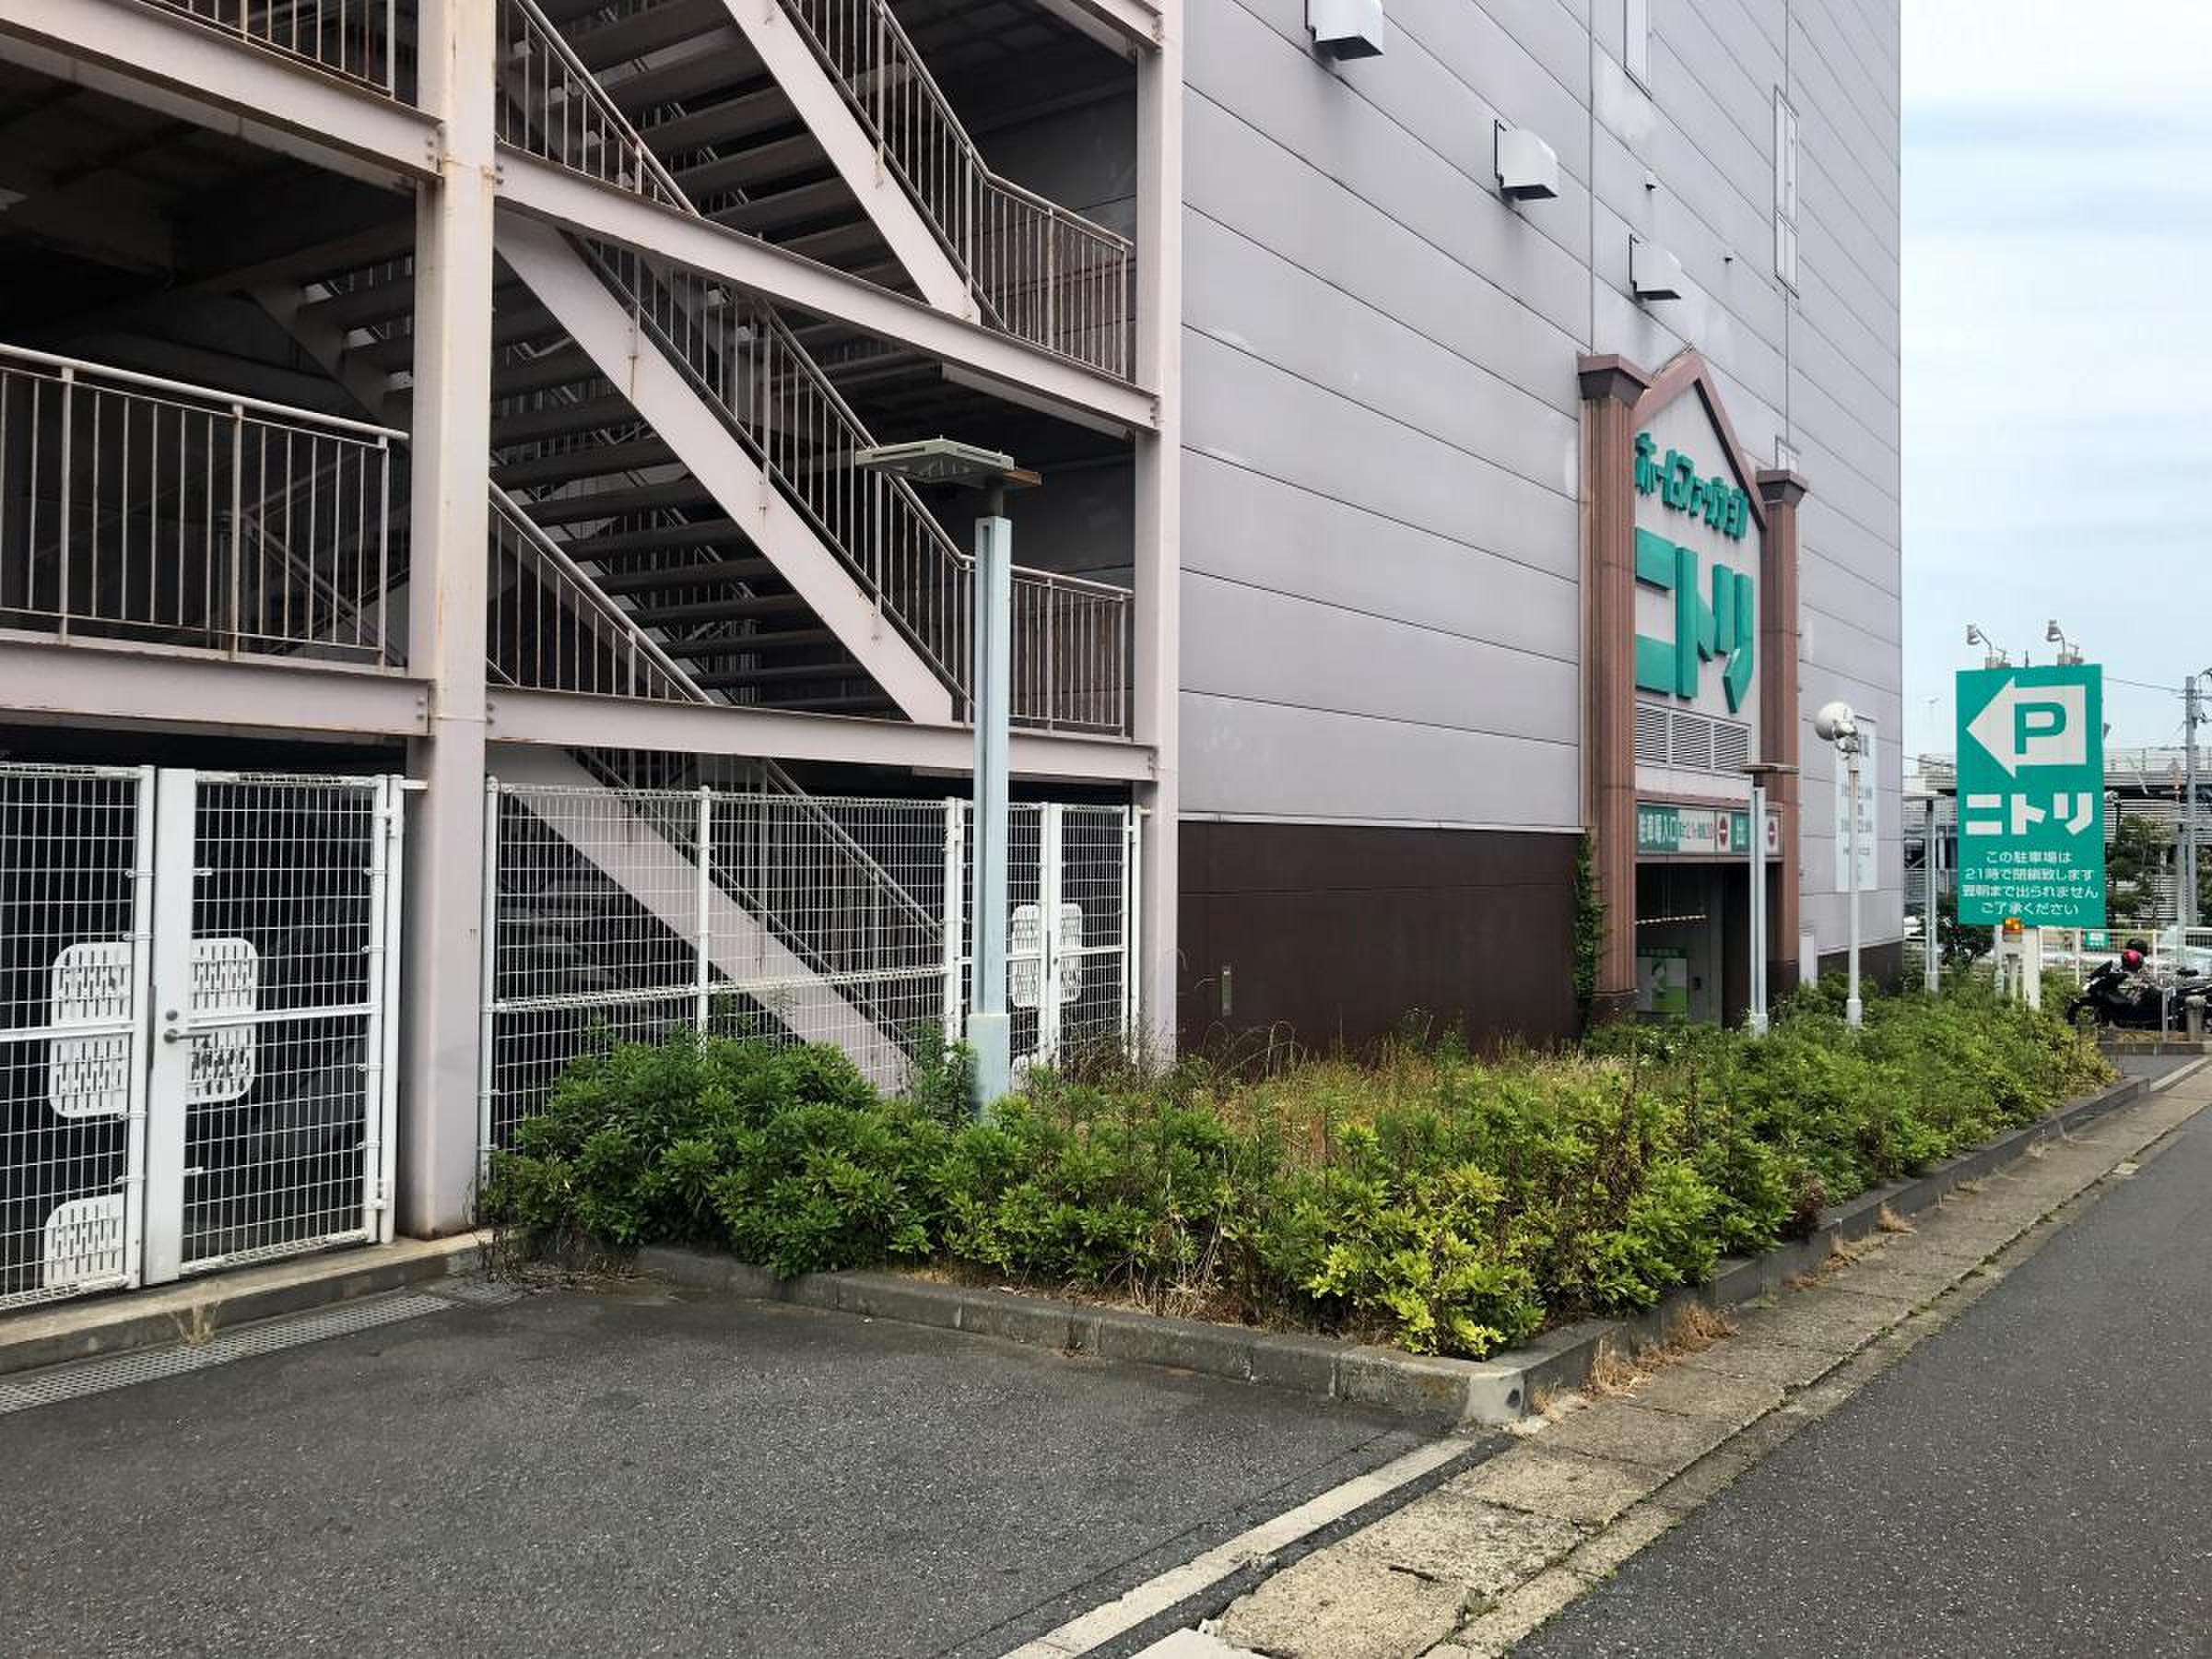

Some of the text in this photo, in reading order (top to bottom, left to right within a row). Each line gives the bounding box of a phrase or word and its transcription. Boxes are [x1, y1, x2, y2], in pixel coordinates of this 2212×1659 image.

[1635, 527, 1754, 713] ニトリ
[2015, 702, 2066, 754] P
[1966, 792, 2094, 836] ニトリ
[1986, 850, 2073, 865] この駐車場は
[1964, 867, 2094, 882] 21時で閉鎖致します
[1961, 884, 2099, 900] 翌朝まで出られません
[1981, 900, 2079, 915] ご了承ください
